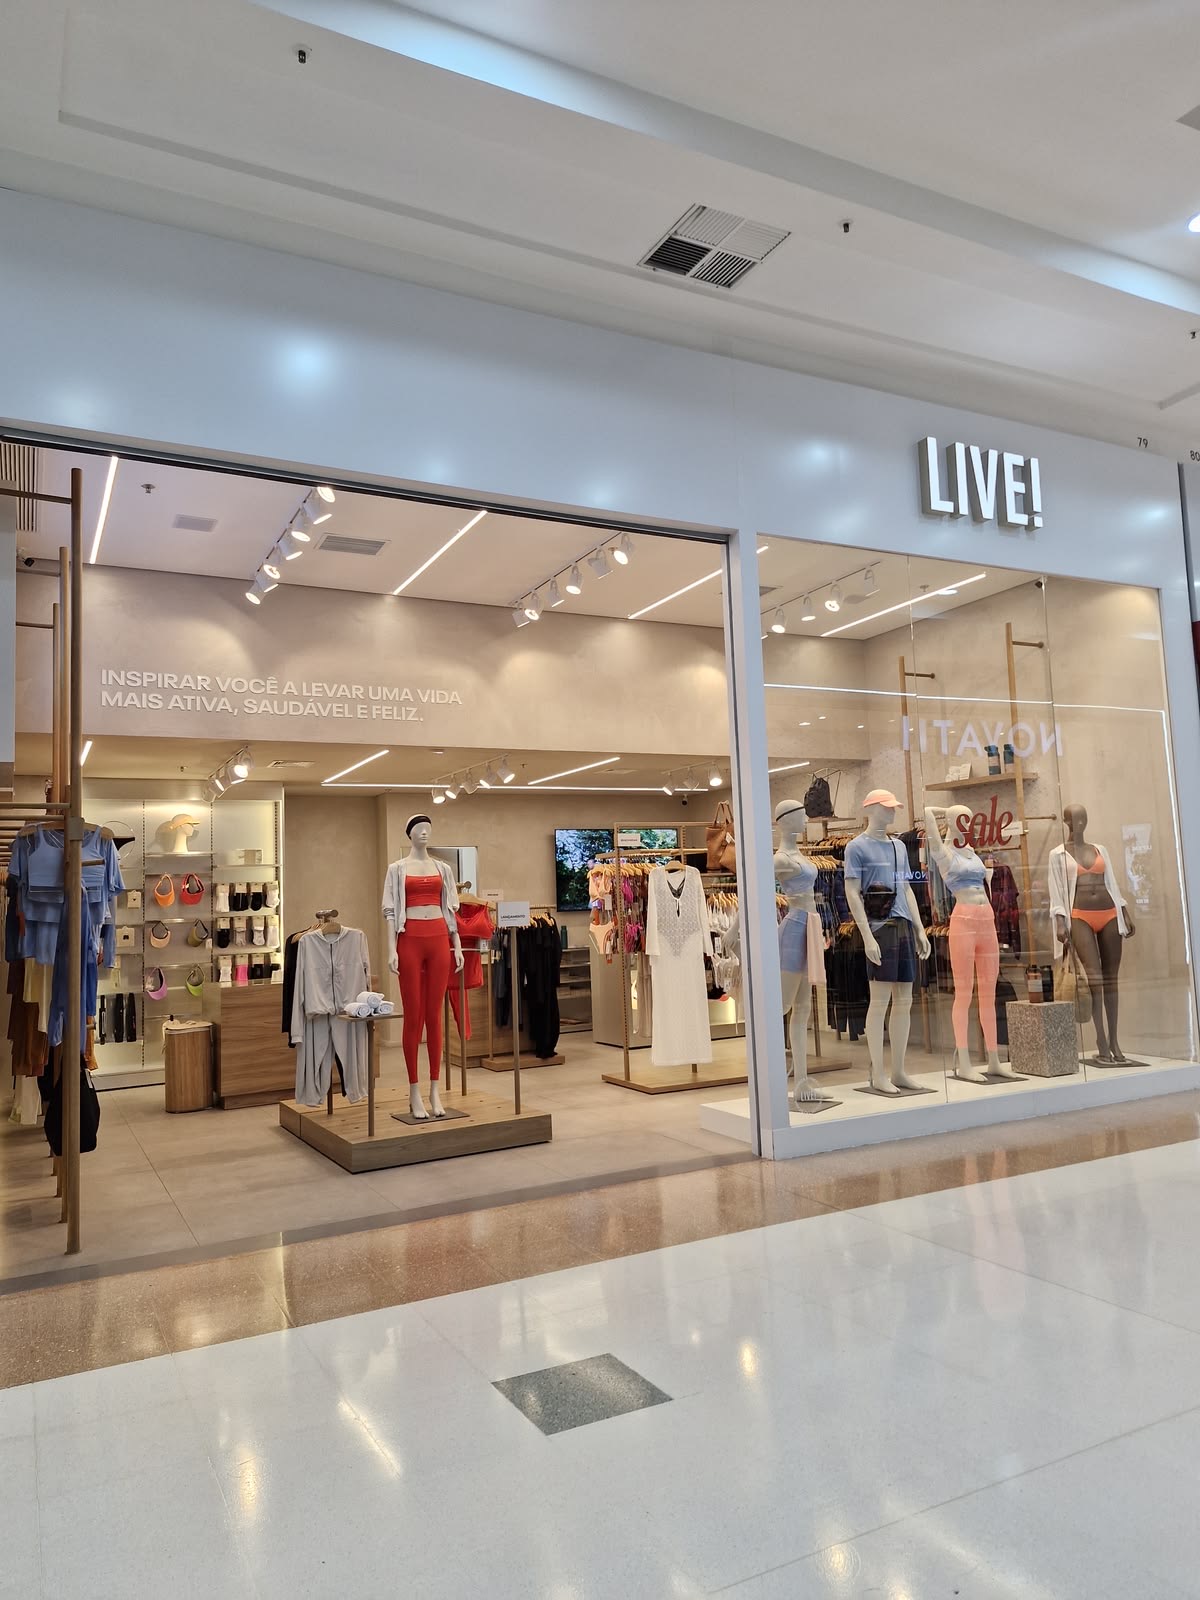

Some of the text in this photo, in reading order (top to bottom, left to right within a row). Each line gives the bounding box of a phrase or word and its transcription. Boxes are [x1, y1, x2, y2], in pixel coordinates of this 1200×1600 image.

[1137, 437, 1148, 448] 79
[1190, 450, 1200, 461] 80
[920, 436, 1043, 530] LIVE!
[101, 669, 462, 705] INSPIRAR VOCÊ A LEVAR UMA VIDA
[101, 691, 424, 722] MAIS ATIVA, SAUDÁVEL E FELIZ.
[953, 794, 1013, 849] sale
